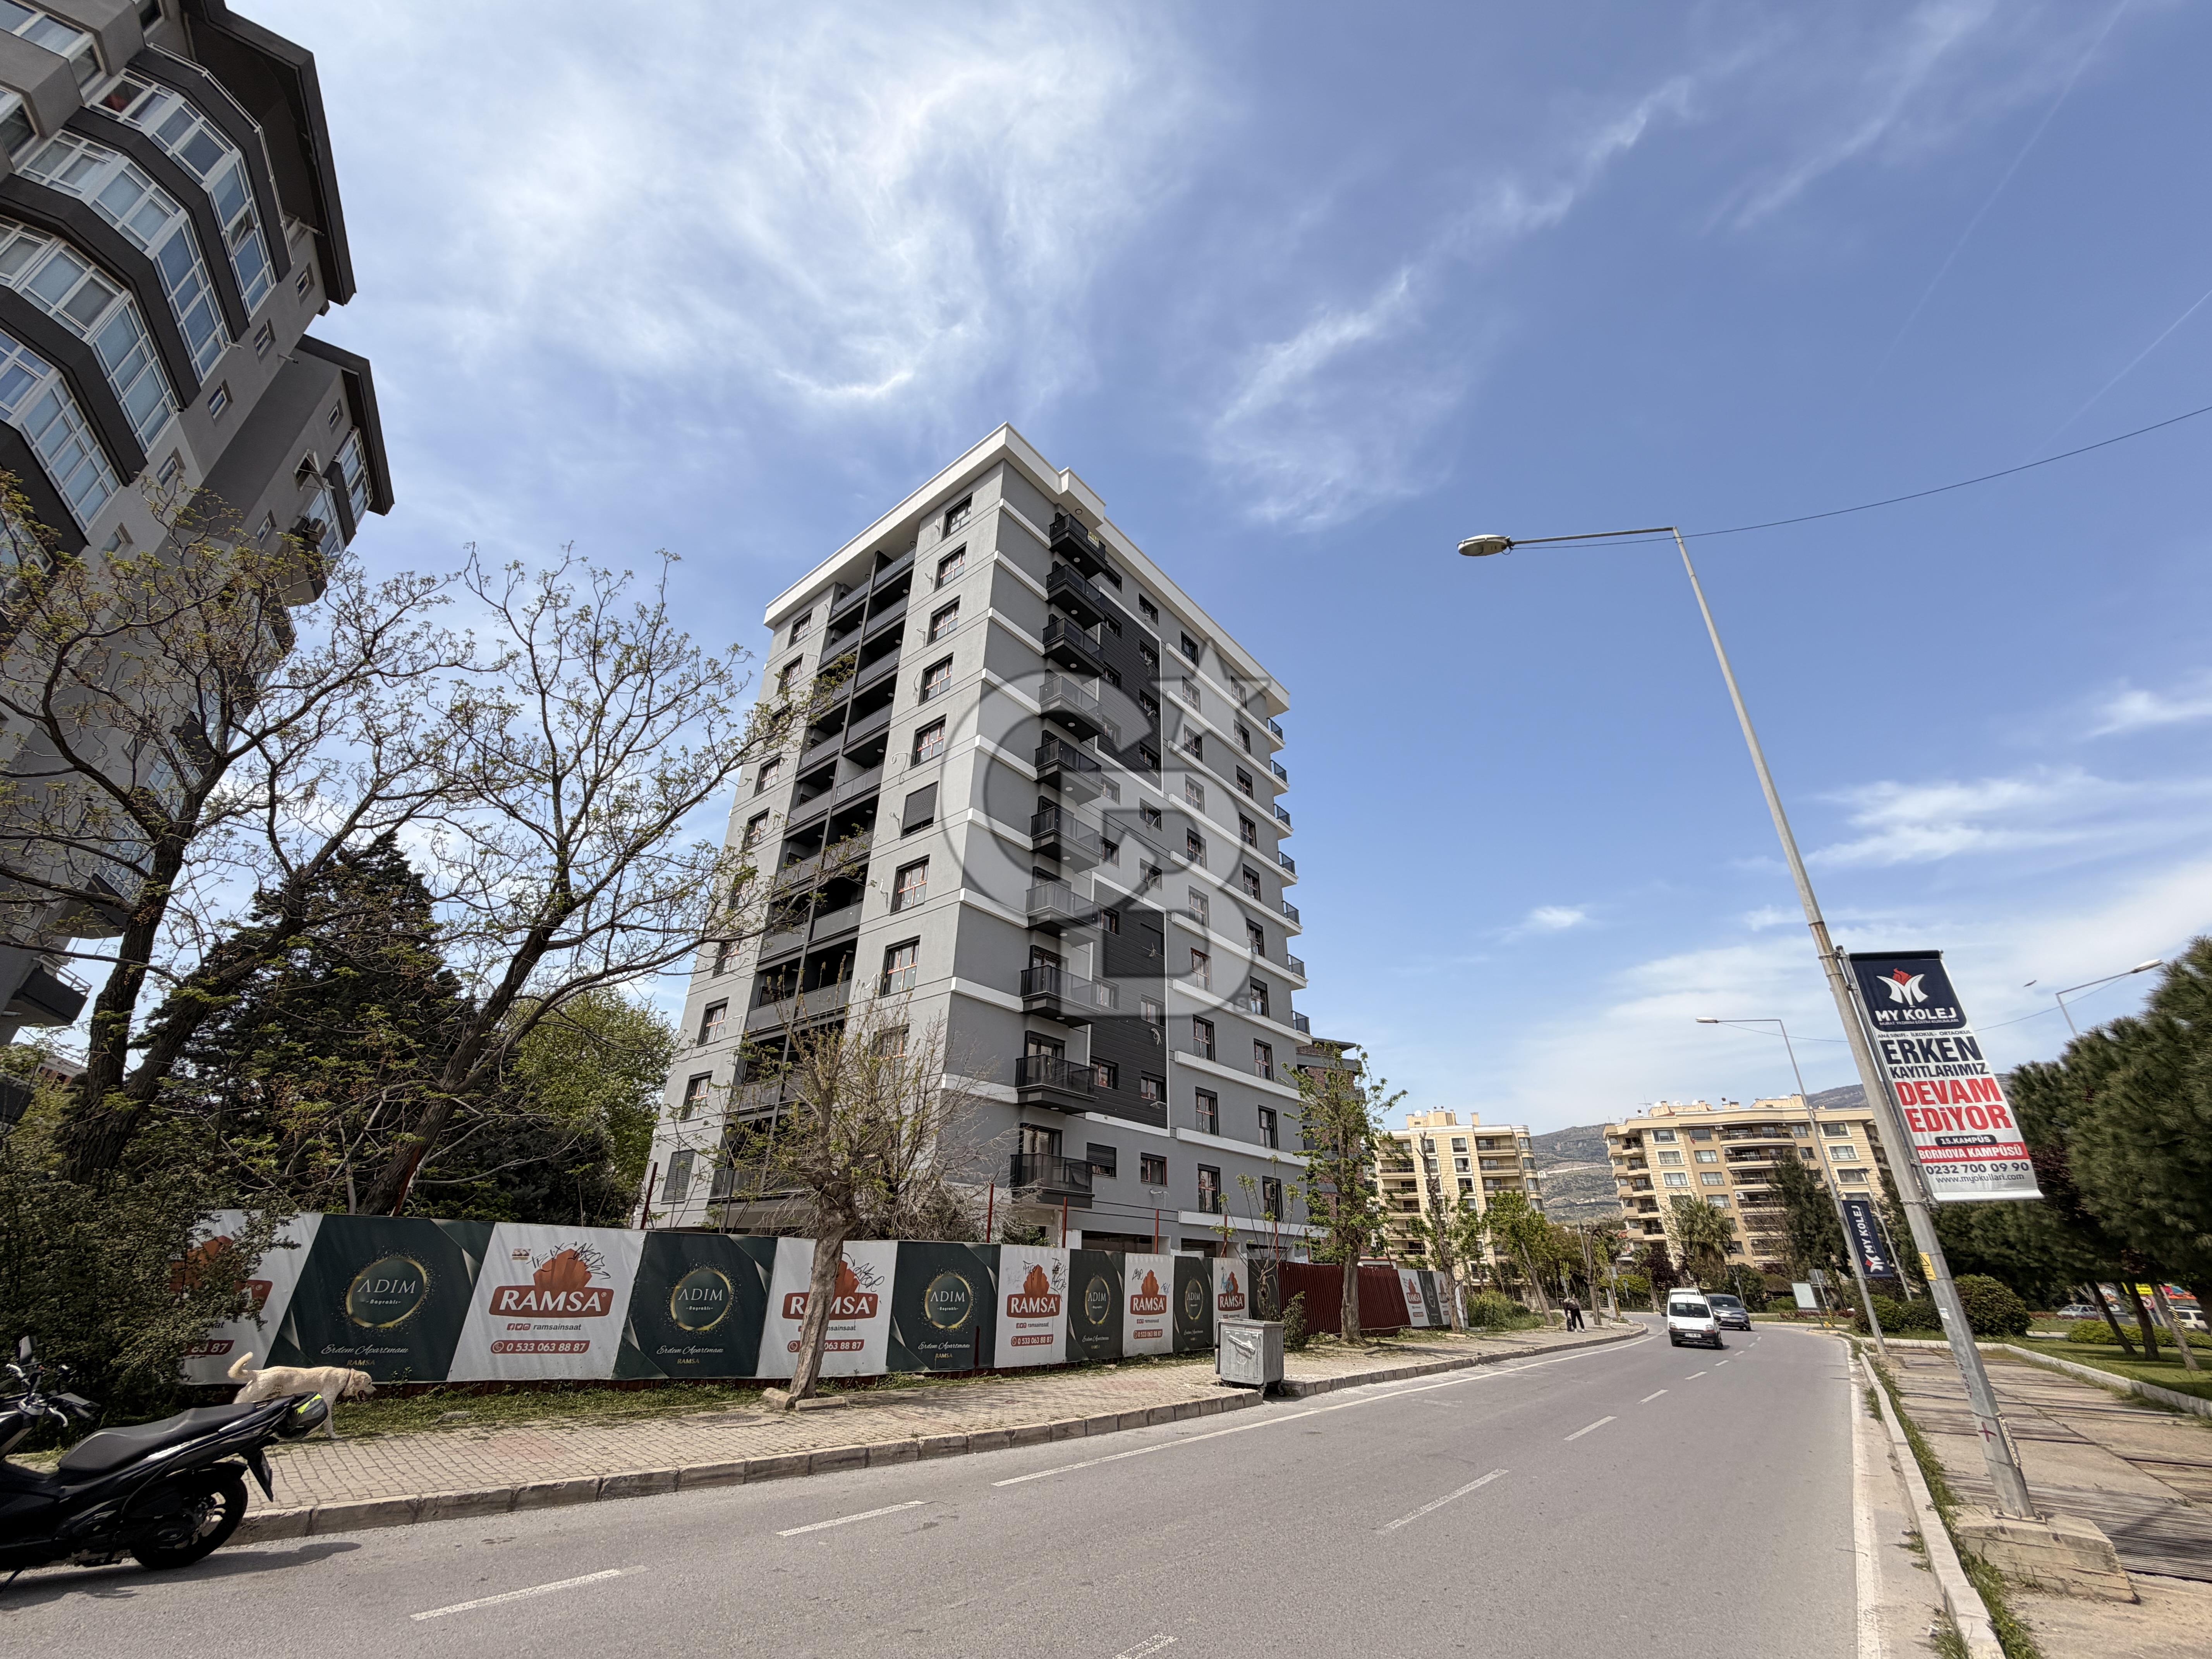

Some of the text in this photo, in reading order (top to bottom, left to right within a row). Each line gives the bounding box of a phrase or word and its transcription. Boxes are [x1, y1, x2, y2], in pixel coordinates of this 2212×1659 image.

[1875, 1007, 1957, 1021] MY KOLEJ
[1879, 1036, 1983, 1065] ERKEN
[1889, 1063, 1990, 1079] KAYITLARIMIZ
[1894, 1077, 2002, 1106] DEVAM
[1917, 1145, 2023, 1159] BORNOVA KAMPÜSÜ
[1926, 1162, 2029, 1175] 0232 700 09 90
[1936, 1173, 2025, 1183] www.myokullari.com
[1851, 1205, 1869, 1237] KOLEJ
[1861, 1238, 1875, 1253] MY
[357, 1279, 416, 1294] ADIM
[678, 1288, 722, 1301] ADIM
[930, 1291, 965, 1302] ADIM
[1088, 1292, 1106, 1302] ADIM
[1187, 1292, 1200, 1301] ADIM
[790, 1296, 870, 1314] RMSA
[210, 1343, 228, 1353] 87
[321, 1344, 355, 1354] Erdem
[507, 1343, 586, 1352] 0 533 063 88 87
[657, 1345, 682, 1354] Erdem
[852, 1341, 861, 1350] 87
[918, 1341, 937, 1350] Erdem
